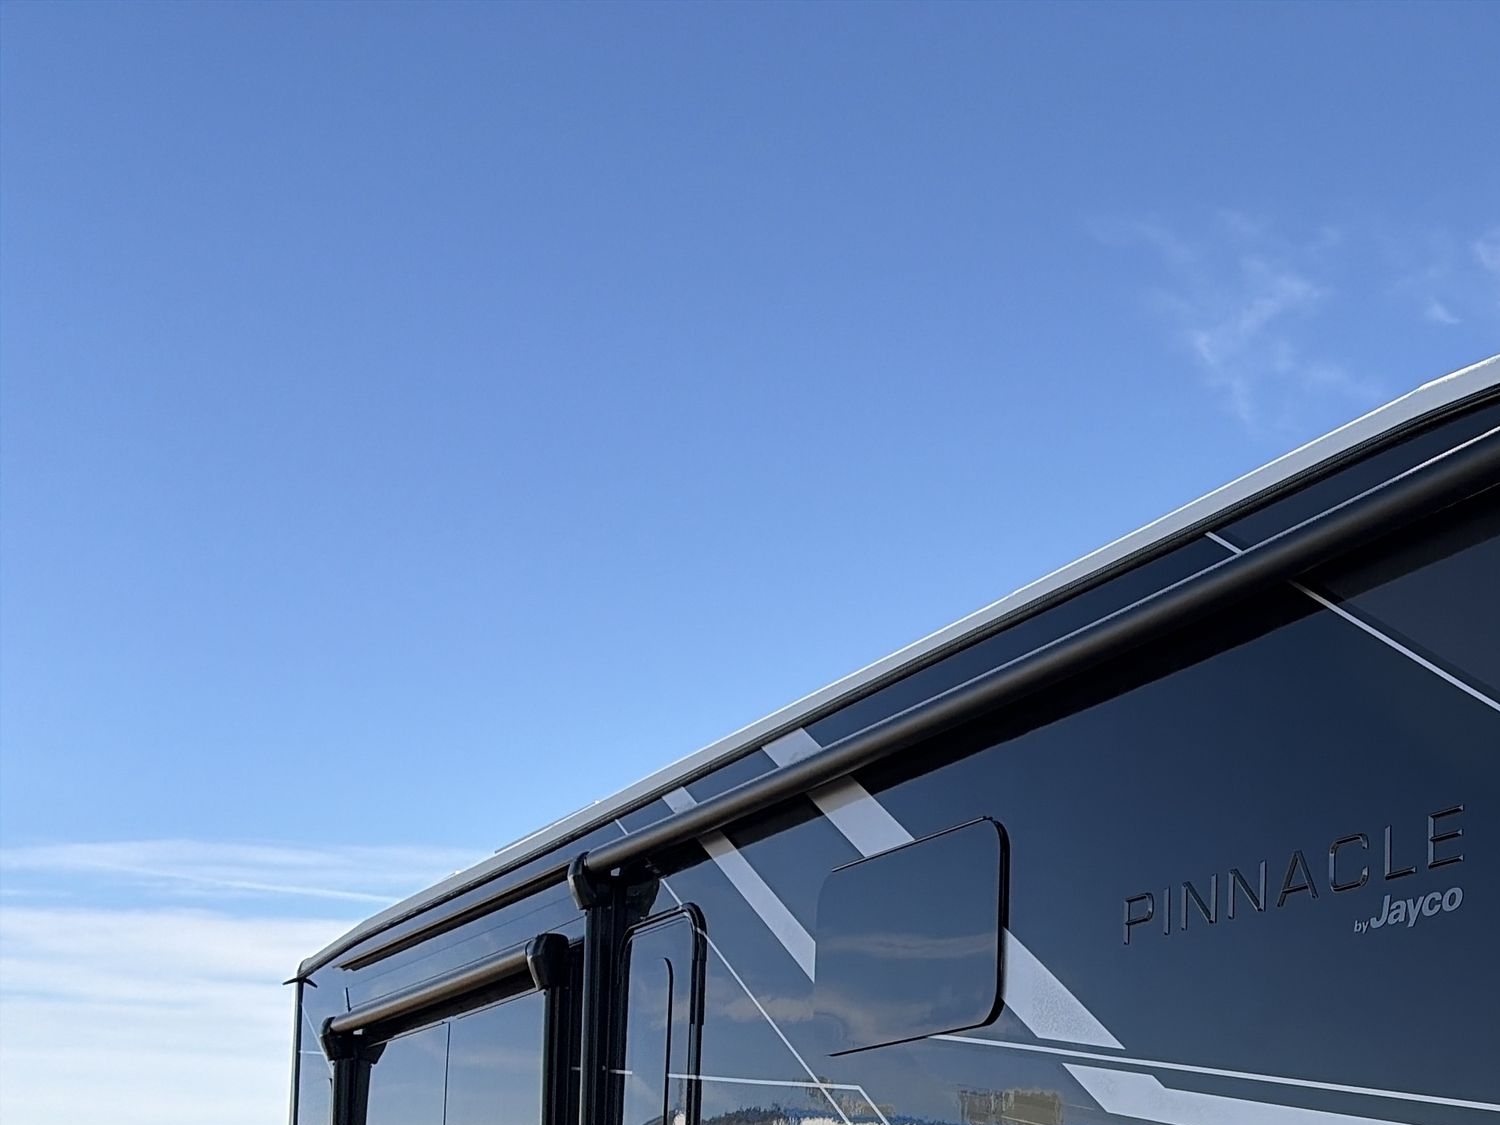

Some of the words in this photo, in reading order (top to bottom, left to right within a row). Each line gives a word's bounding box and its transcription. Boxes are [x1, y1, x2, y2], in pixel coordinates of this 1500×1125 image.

[1123, 804, 1465, 946] PINNACLE
[1353, 918, 1370, 934] by
[1370, 887, 1464, 928] Jayco
